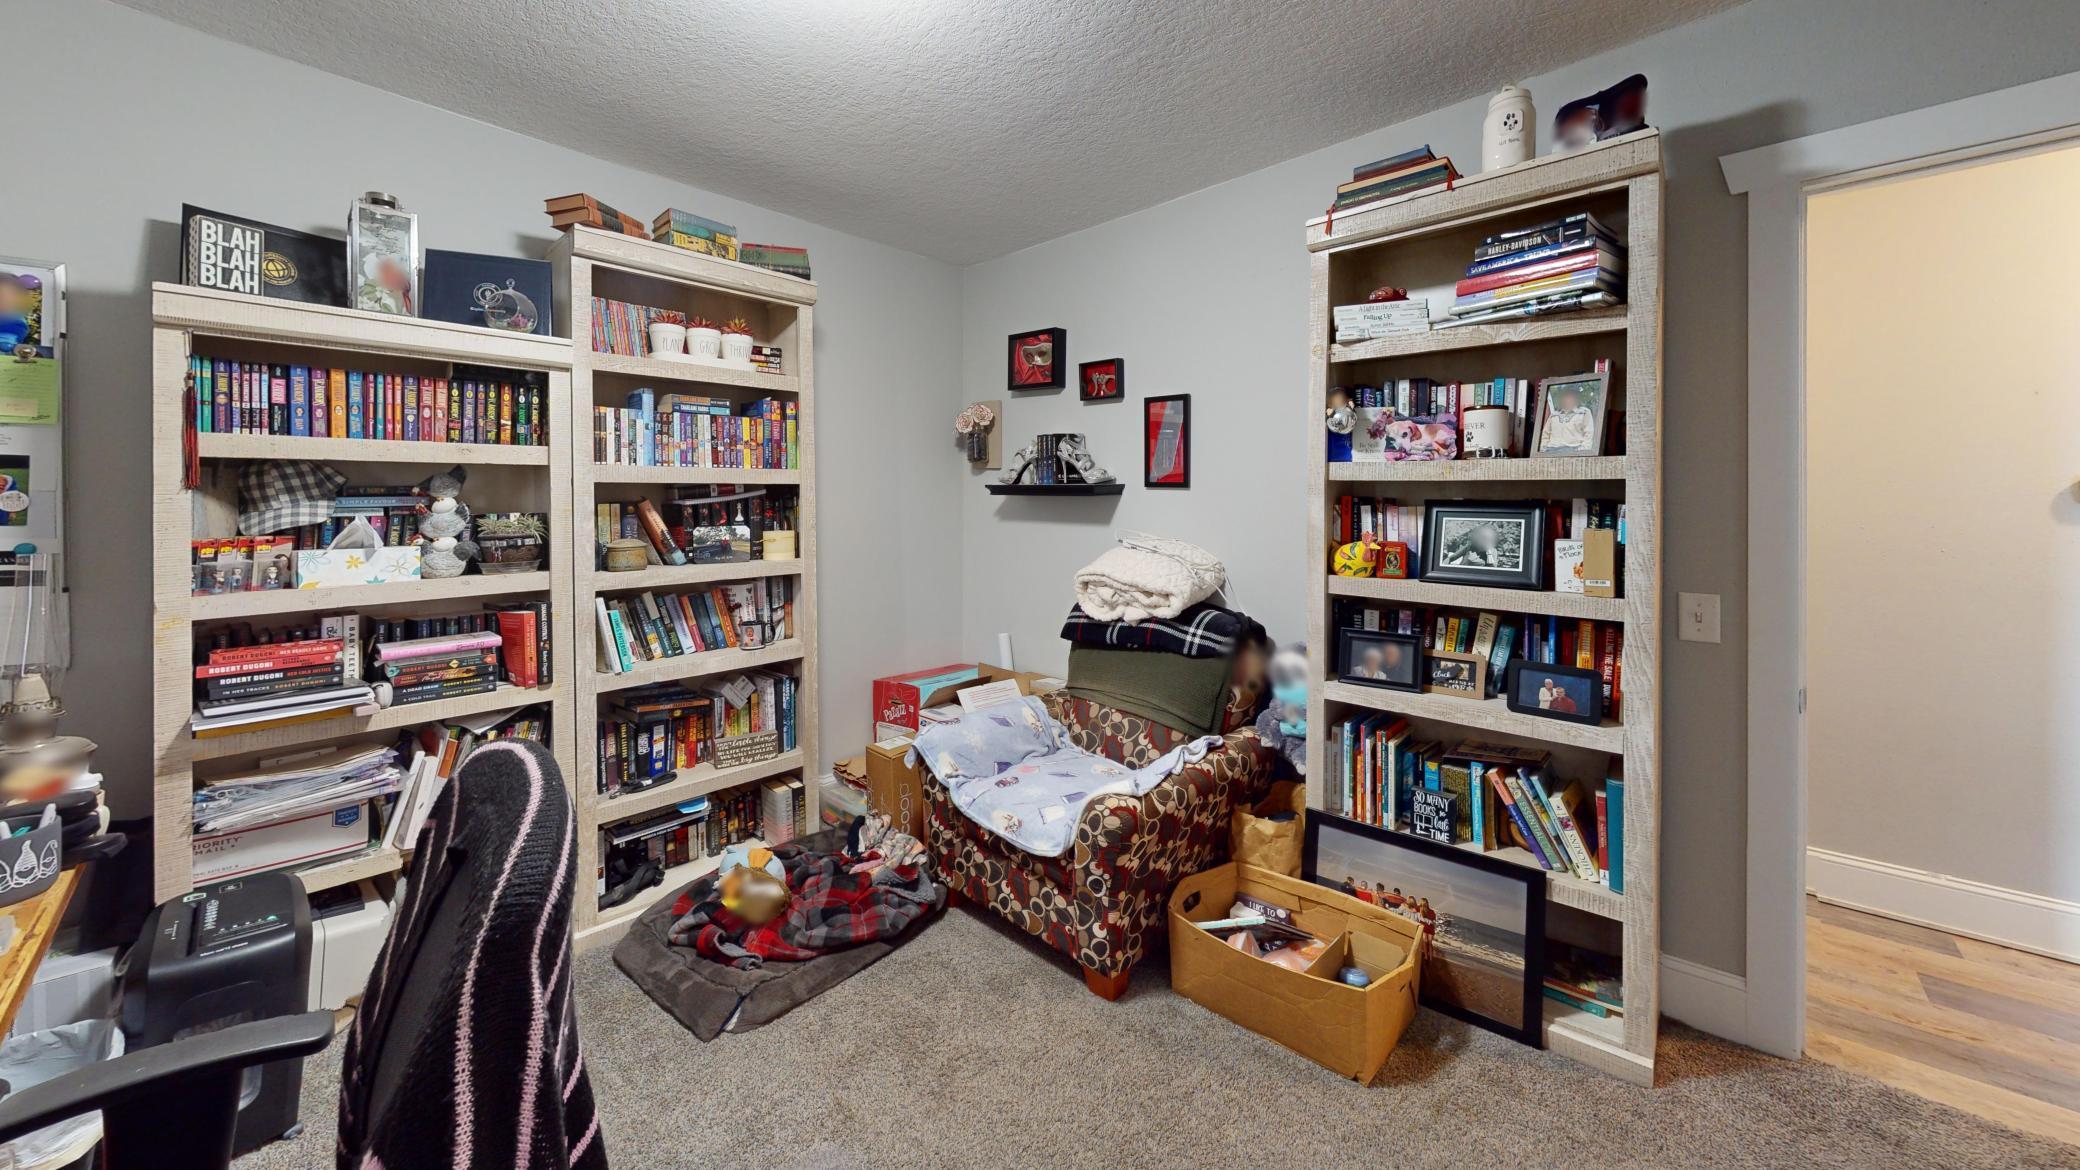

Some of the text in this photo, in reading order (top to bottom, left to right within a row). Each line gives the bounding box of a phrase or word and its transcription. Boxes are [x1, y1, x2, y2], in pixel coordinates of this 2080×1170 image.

[201, 219, 260, 254] BLAH
[1488, 236, 1542, 255] HARLEY-DAVIDSON
[200, 241, 260, 275] BLAH
[200, 263, 260, 295] BLAH
[1363, 311, 1393, 321] Falling Up
[208, 661, 273, 675] ROBERT DUGONI
[348, 652, 356, 679] TEETH
[1603, 665, 1613, 682] SALE
[220, 675, 252, 685] ROBERT
[253, 672, 284, 681] DUGONI
[1414, 790, 1450, 812] SO MANY
[1414, 802, 1437, 817] BOOKS
[1518, 800, 1544, 842] ESSENTIAL
[192, 836, 241, 851] RIORITY
[1429, 828, 1450, 843] TIME
[1569, 832, 1594, 877] CHICKENS
[1252, 903, 1266, 913] LIKE
[1266, 907, 1276, 918] TO
